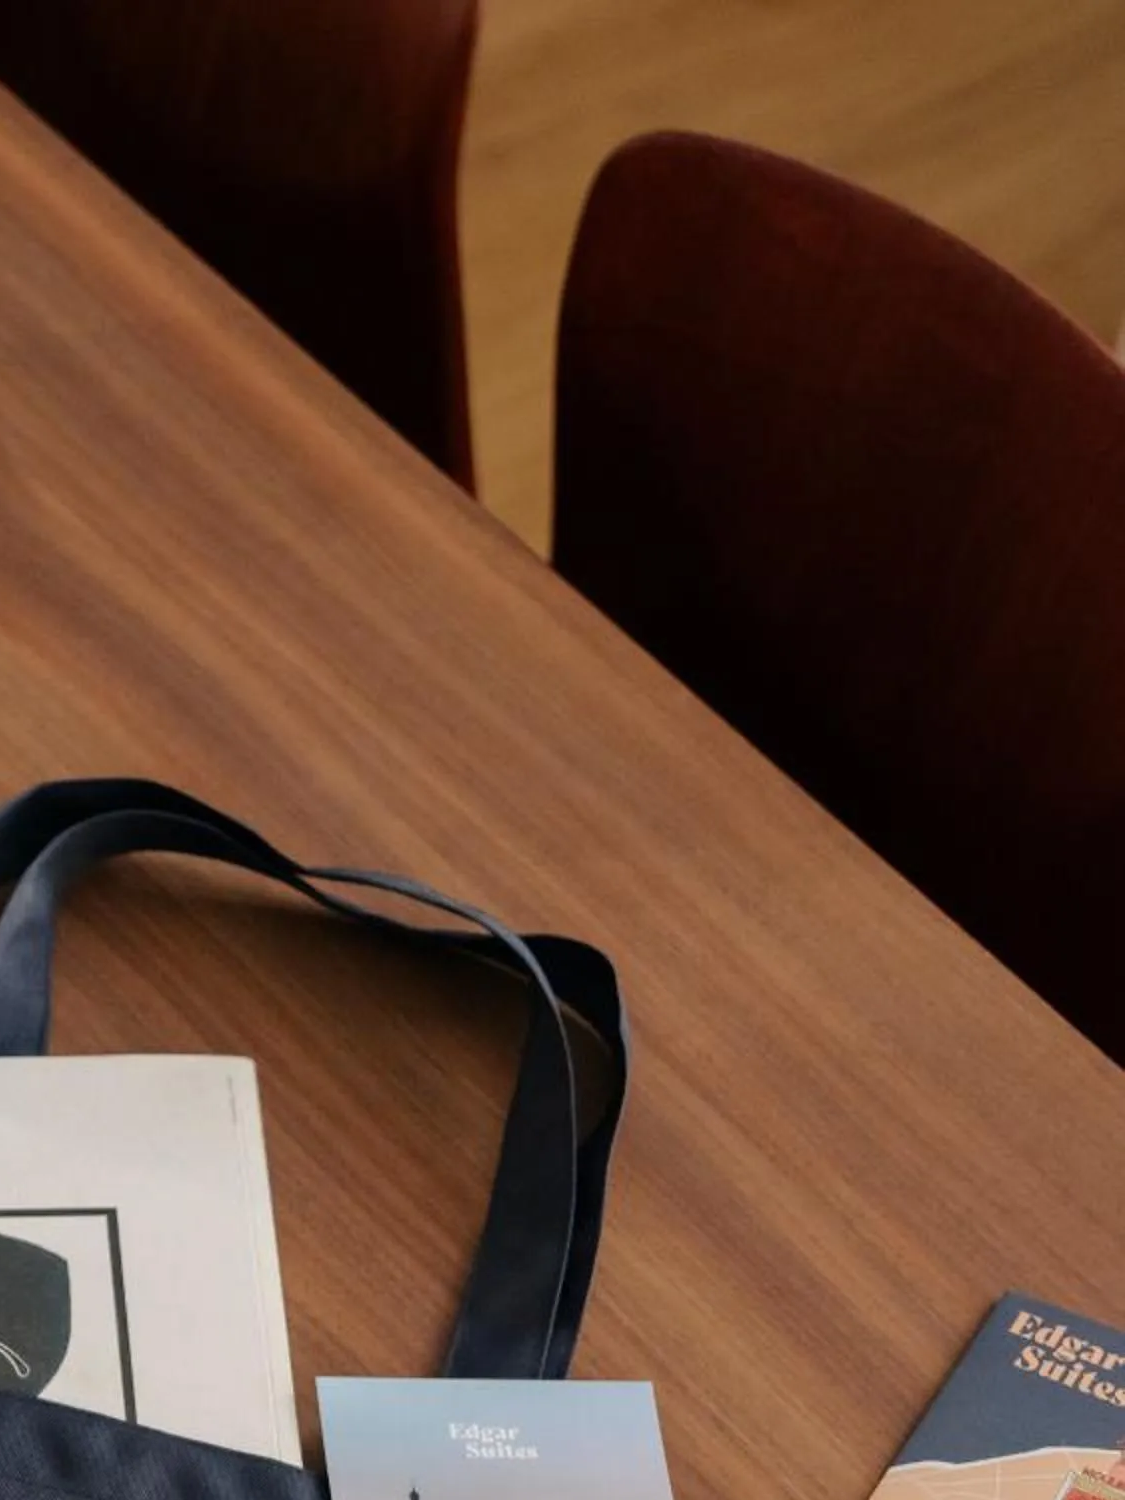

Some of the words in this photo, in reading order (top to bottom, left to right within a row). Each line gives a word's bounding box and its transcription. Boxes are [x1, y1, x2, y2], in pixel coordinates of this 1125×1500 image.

[1007, 1311, 1125, 1371] Edgar
[449, 1422, 520, 1443] Edgar
[465, 1441, 539, 1460] Suites
